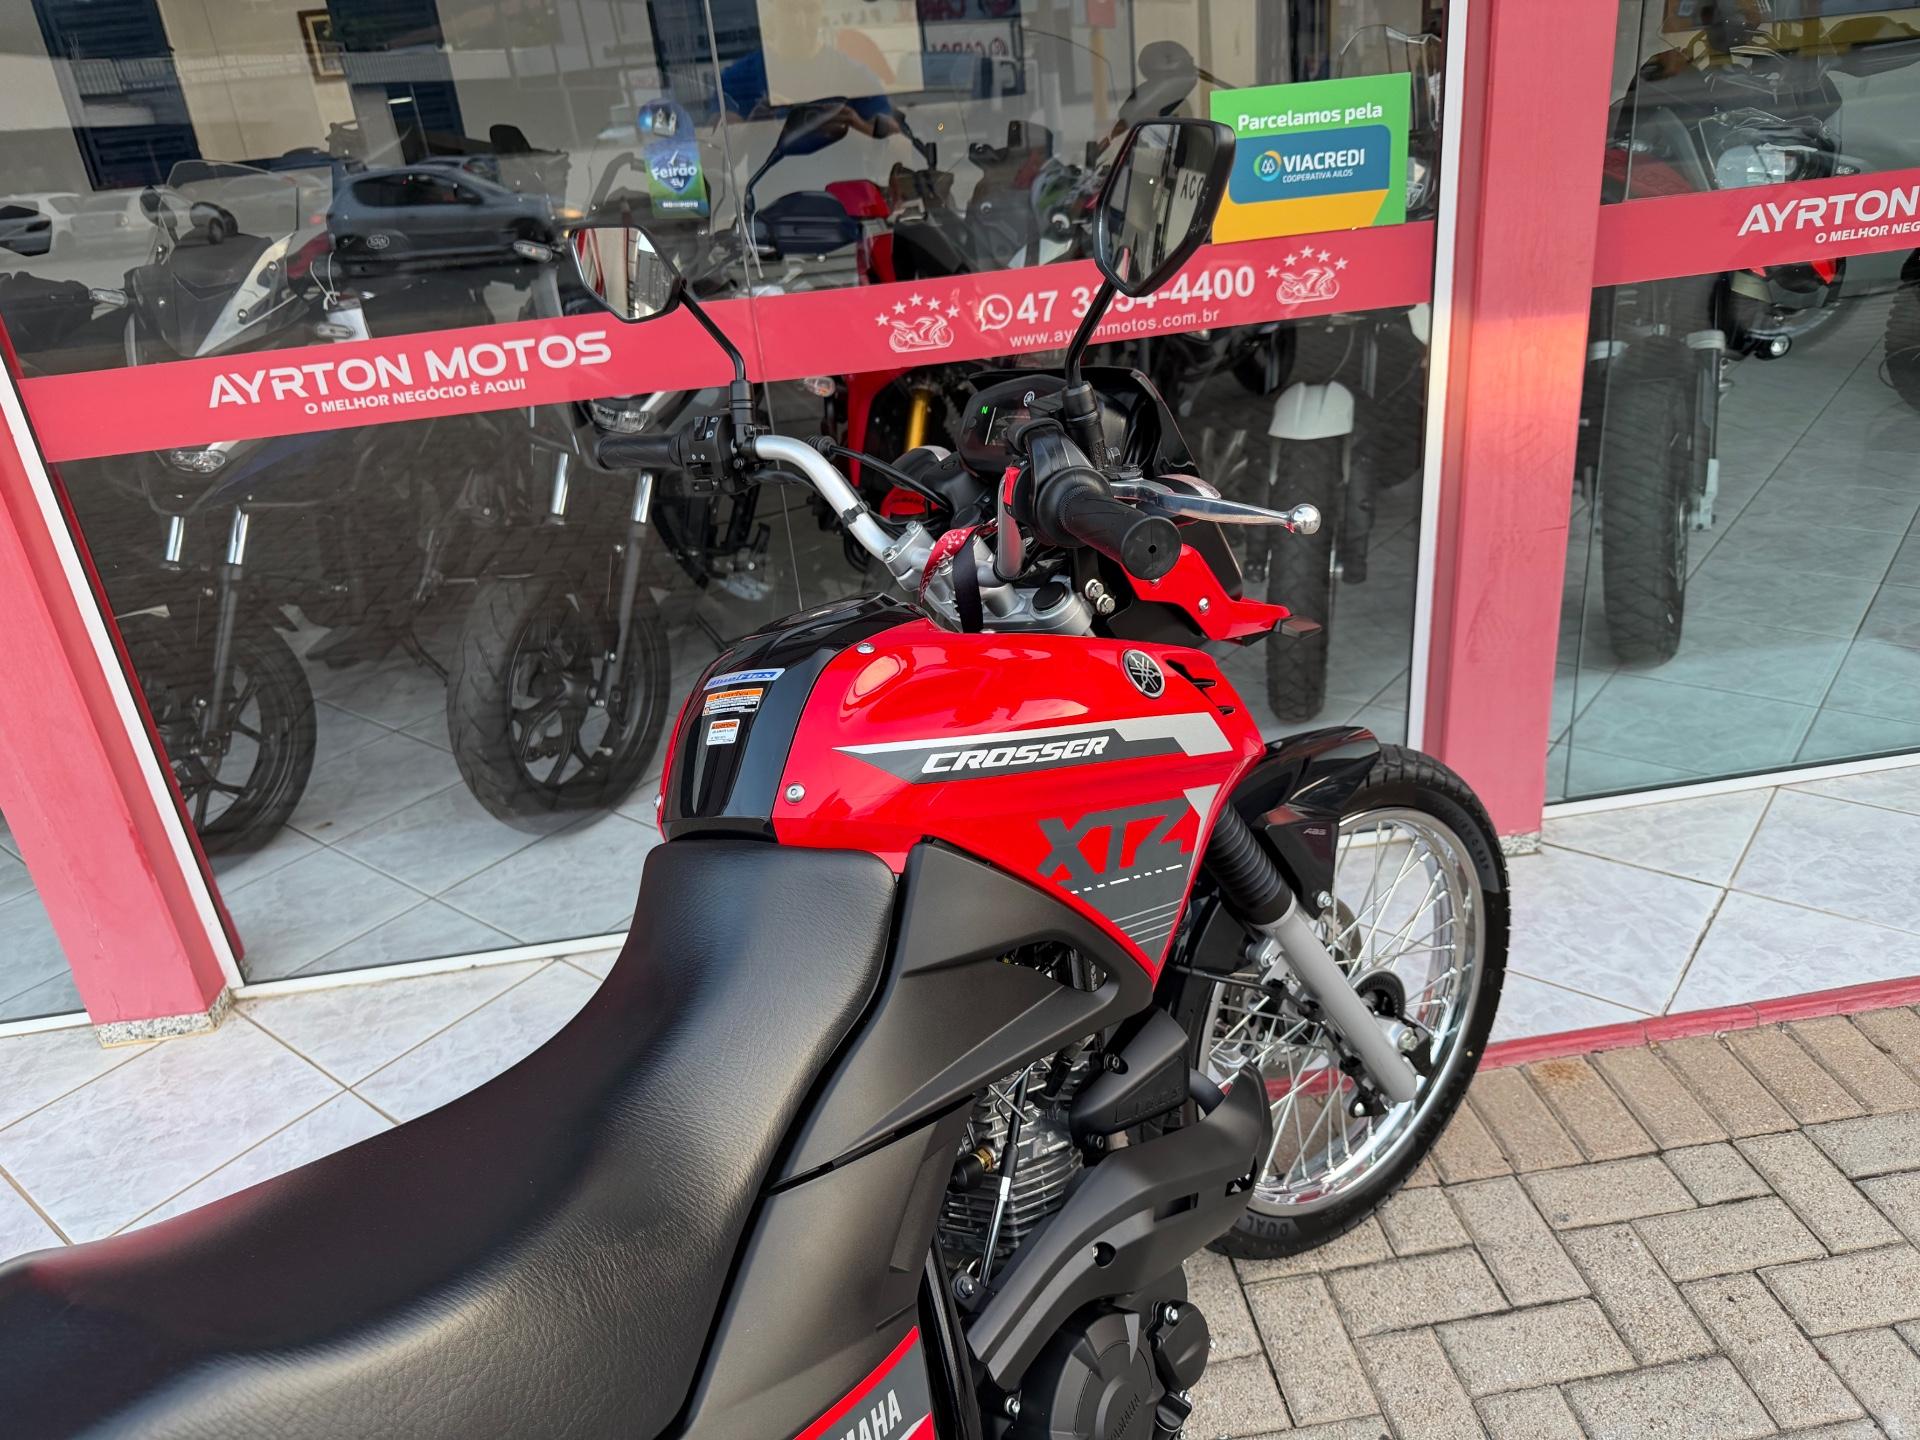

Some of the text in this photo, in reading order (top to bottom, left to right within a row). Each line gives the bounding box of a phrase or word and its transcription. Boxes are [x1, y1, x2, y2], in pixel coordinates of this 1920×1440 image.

[1238, 102, 1383, 131] Parcelamos pela
[651, 163, 698, 181] Feirão
[1282, 148, 1366, 173] VIACREDI
[1282, 168, 1353, 183] COOPERATIVA AILOS
[1737, 185, 1920, 237] AYRTON
[1815, 232, 1827, 244] O
[1828, 225, 1888, 242] MELHOR
[1016, 266, 1255, 325] 47 35-4400
[1010, 309, 1220, 348] www.aynmotos.com.br
[209, 330, 612, 409] AYRTON MOTOS
[304, 376, 526, 415] O MELHOR NEGÓCIO É AQUI
[921, 735, 1109, 774] CROSSER
[1037, 797, 1192, 889] XTZ
